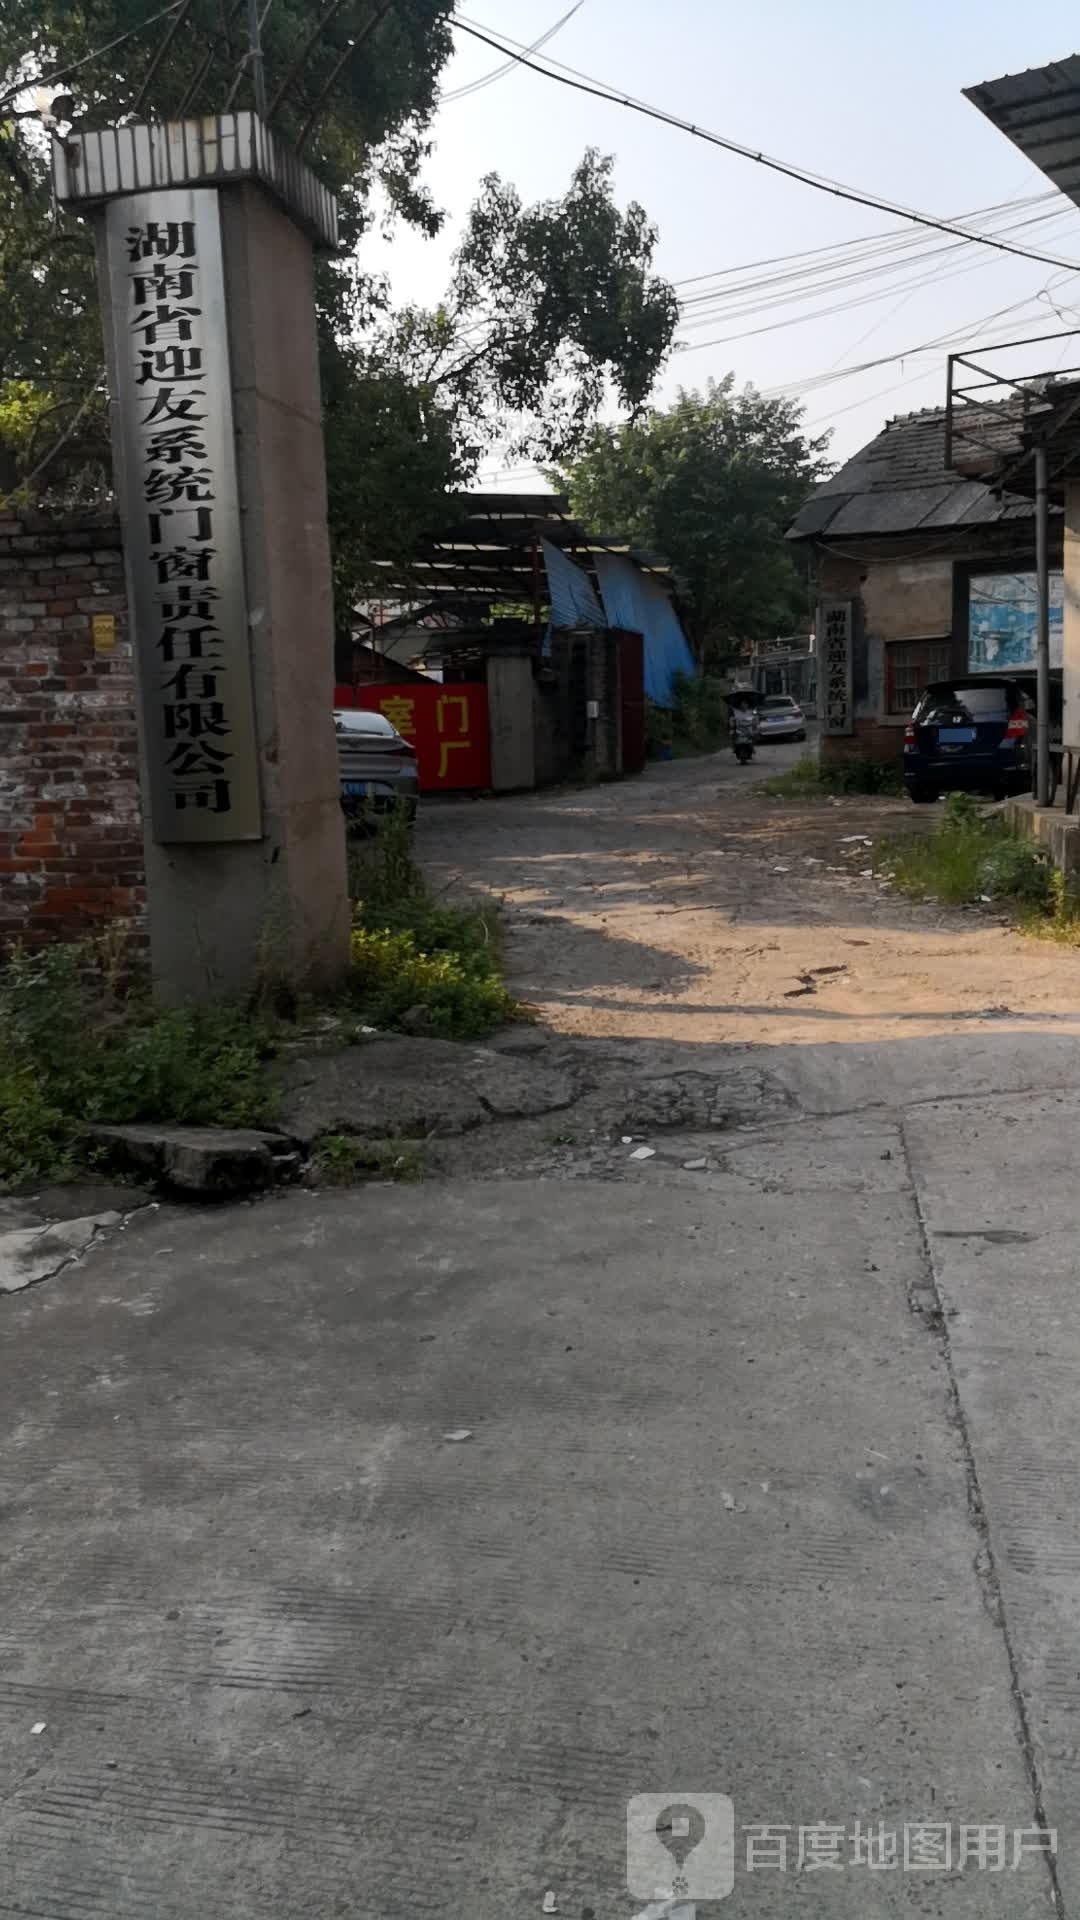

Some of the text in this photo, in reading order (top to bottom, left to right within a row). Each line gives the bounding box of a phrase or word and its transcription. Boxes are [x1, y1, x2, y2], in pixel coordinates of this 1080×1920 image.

[125, 221, 233, 813] 湖南省迎友系统门窗责任有限公司
